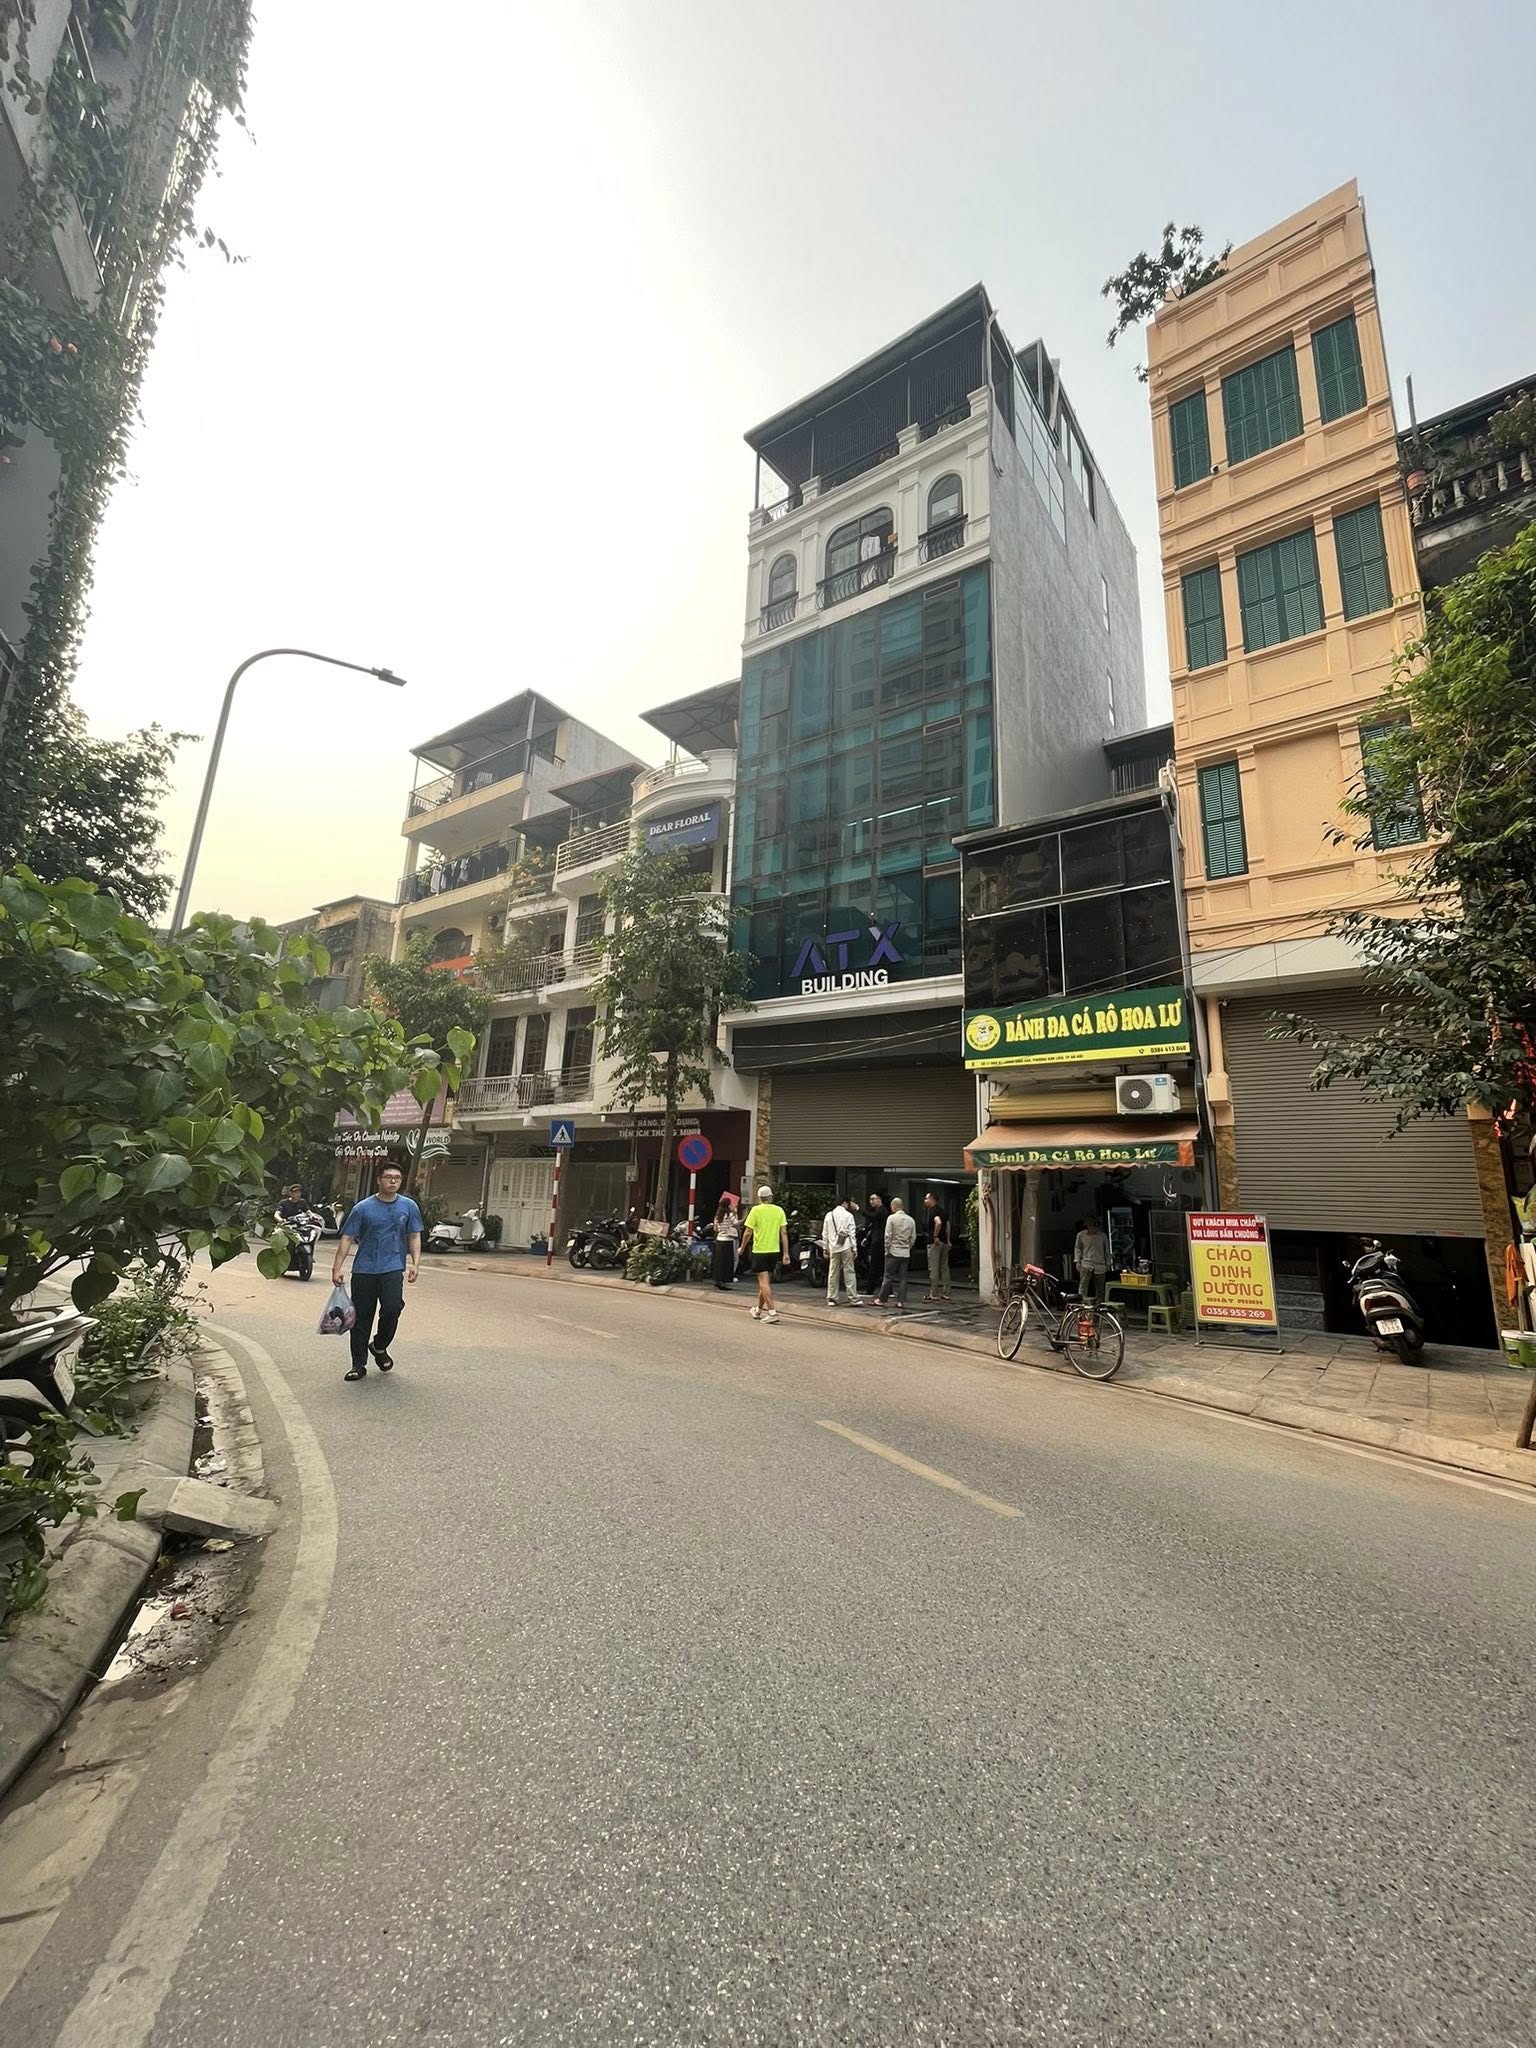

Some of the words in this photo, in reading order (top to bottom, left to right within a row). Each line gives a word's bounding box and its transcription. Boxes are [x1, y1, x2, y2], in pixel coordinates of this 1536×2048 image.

[650, 823, 674, 836] DEAR
[674, 812, 711, 828] FLORAL
[789, 920, 904, 977] ATX
[801, 968, 889, 995] BUILDING
[1005, 1014, 1045, 1042] BÁNH
[1047, 1015, 1070, 1038] ĐA
[1071, 1006, 1094, 1036] CÁ
[1095, 1002, 1119, 1033] RÔ
[1121, 1005, 1157, 1031] HOA
[1158, 998, 1182, 1027] LƯ
[652, 1126, 678, 1137] THÔG
[426, 1136, 450, 1144] WORLD
[989, 1151, 1025, 1164] Bánh
[1028, 1151, 1048, 1162] Đa
[1051, 1150, 1071, 1162] Cá
[1074, 1149, 1096, 1161] Rô
[1099, 1148, 1130, 1160] Hoa
[1210, 1265, 1251, 1279] DINH
[1203, 1280, 1264, 1297] DƯỠNG
[1206, 1307, 1229, 1316] 0356
[1230, 1308, 1247, 1317] 955
[1248, 1310, 1266, 1318] 269
